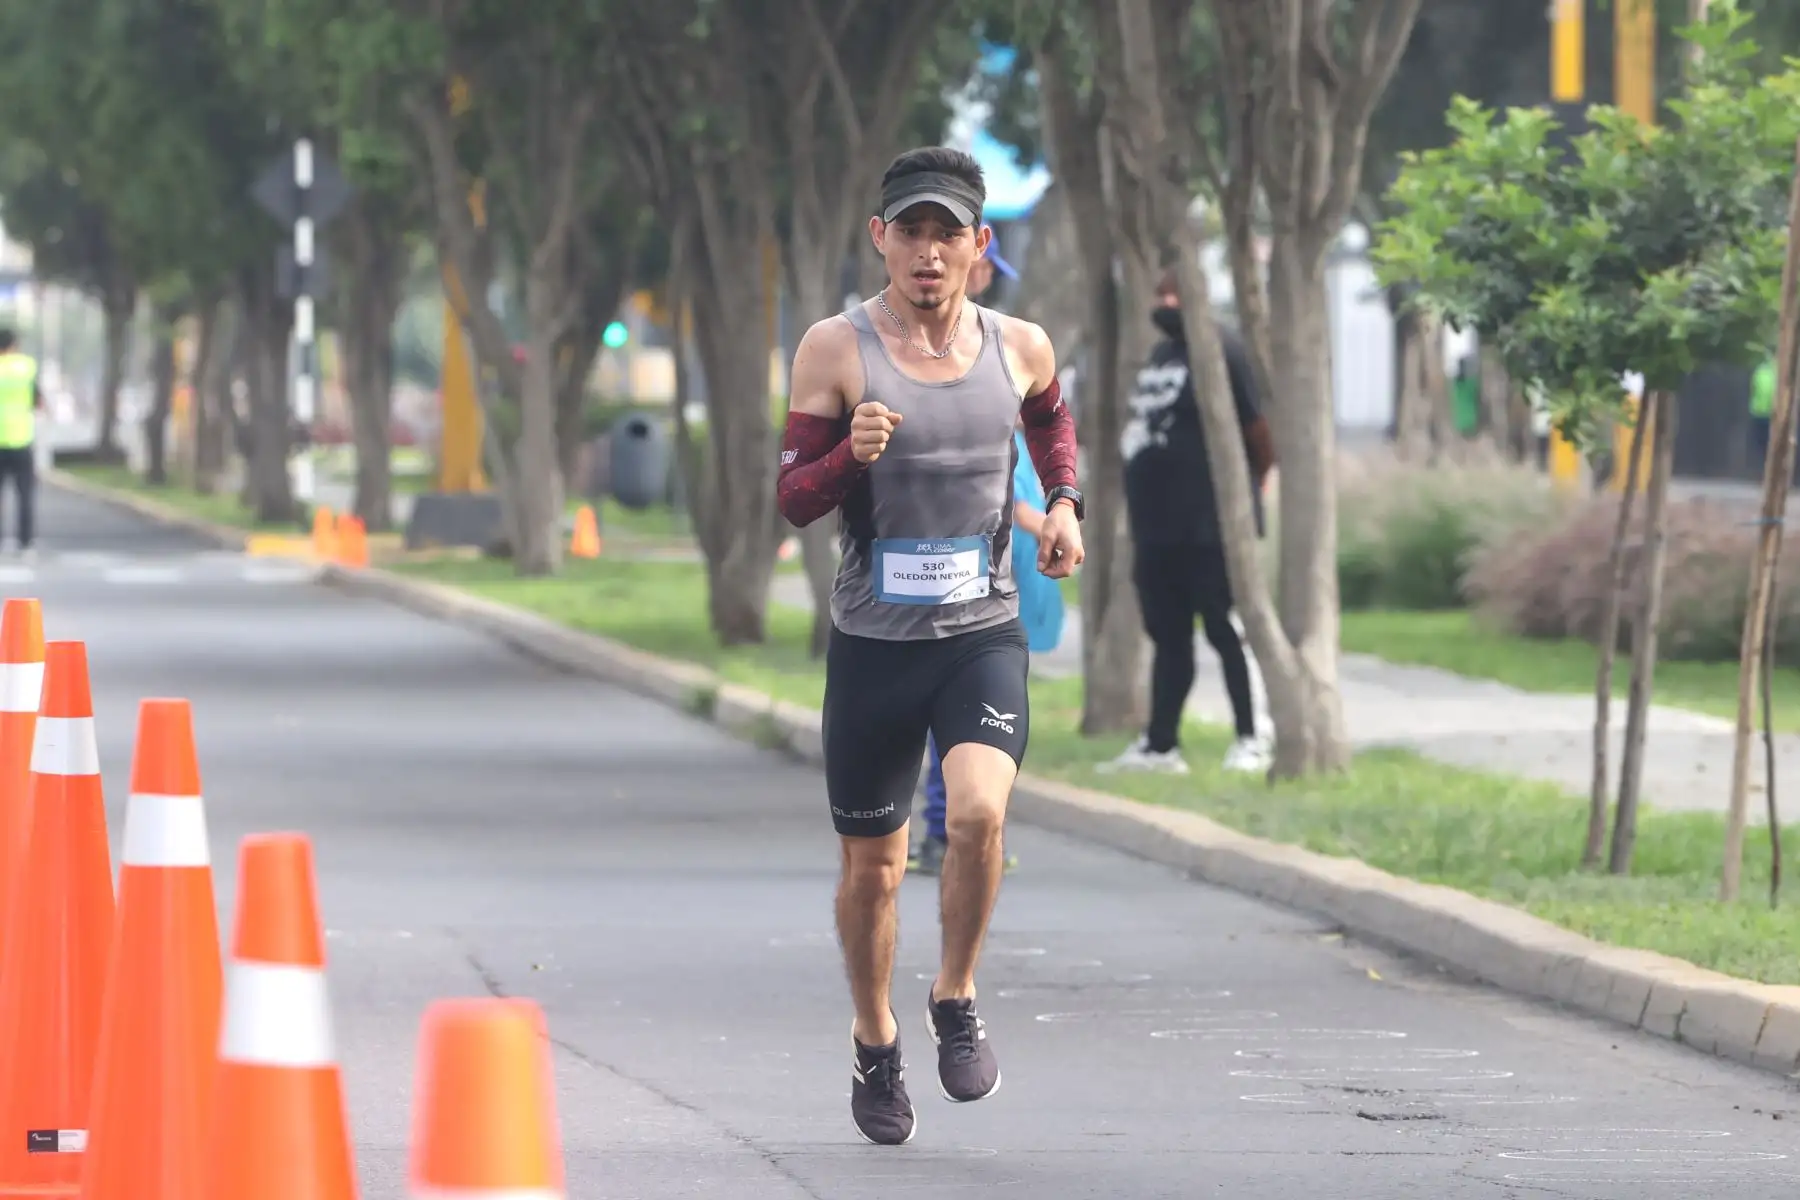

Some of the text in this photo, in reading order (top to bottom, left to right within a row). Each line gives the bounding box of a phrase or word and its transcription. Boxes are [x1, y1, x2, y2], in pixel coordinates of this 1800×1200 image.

[922, 562, 945, 571] 530
[893, 569, 971, 580] OLEDON NEYRA
[832, 801, 895, 819] OLEDON
